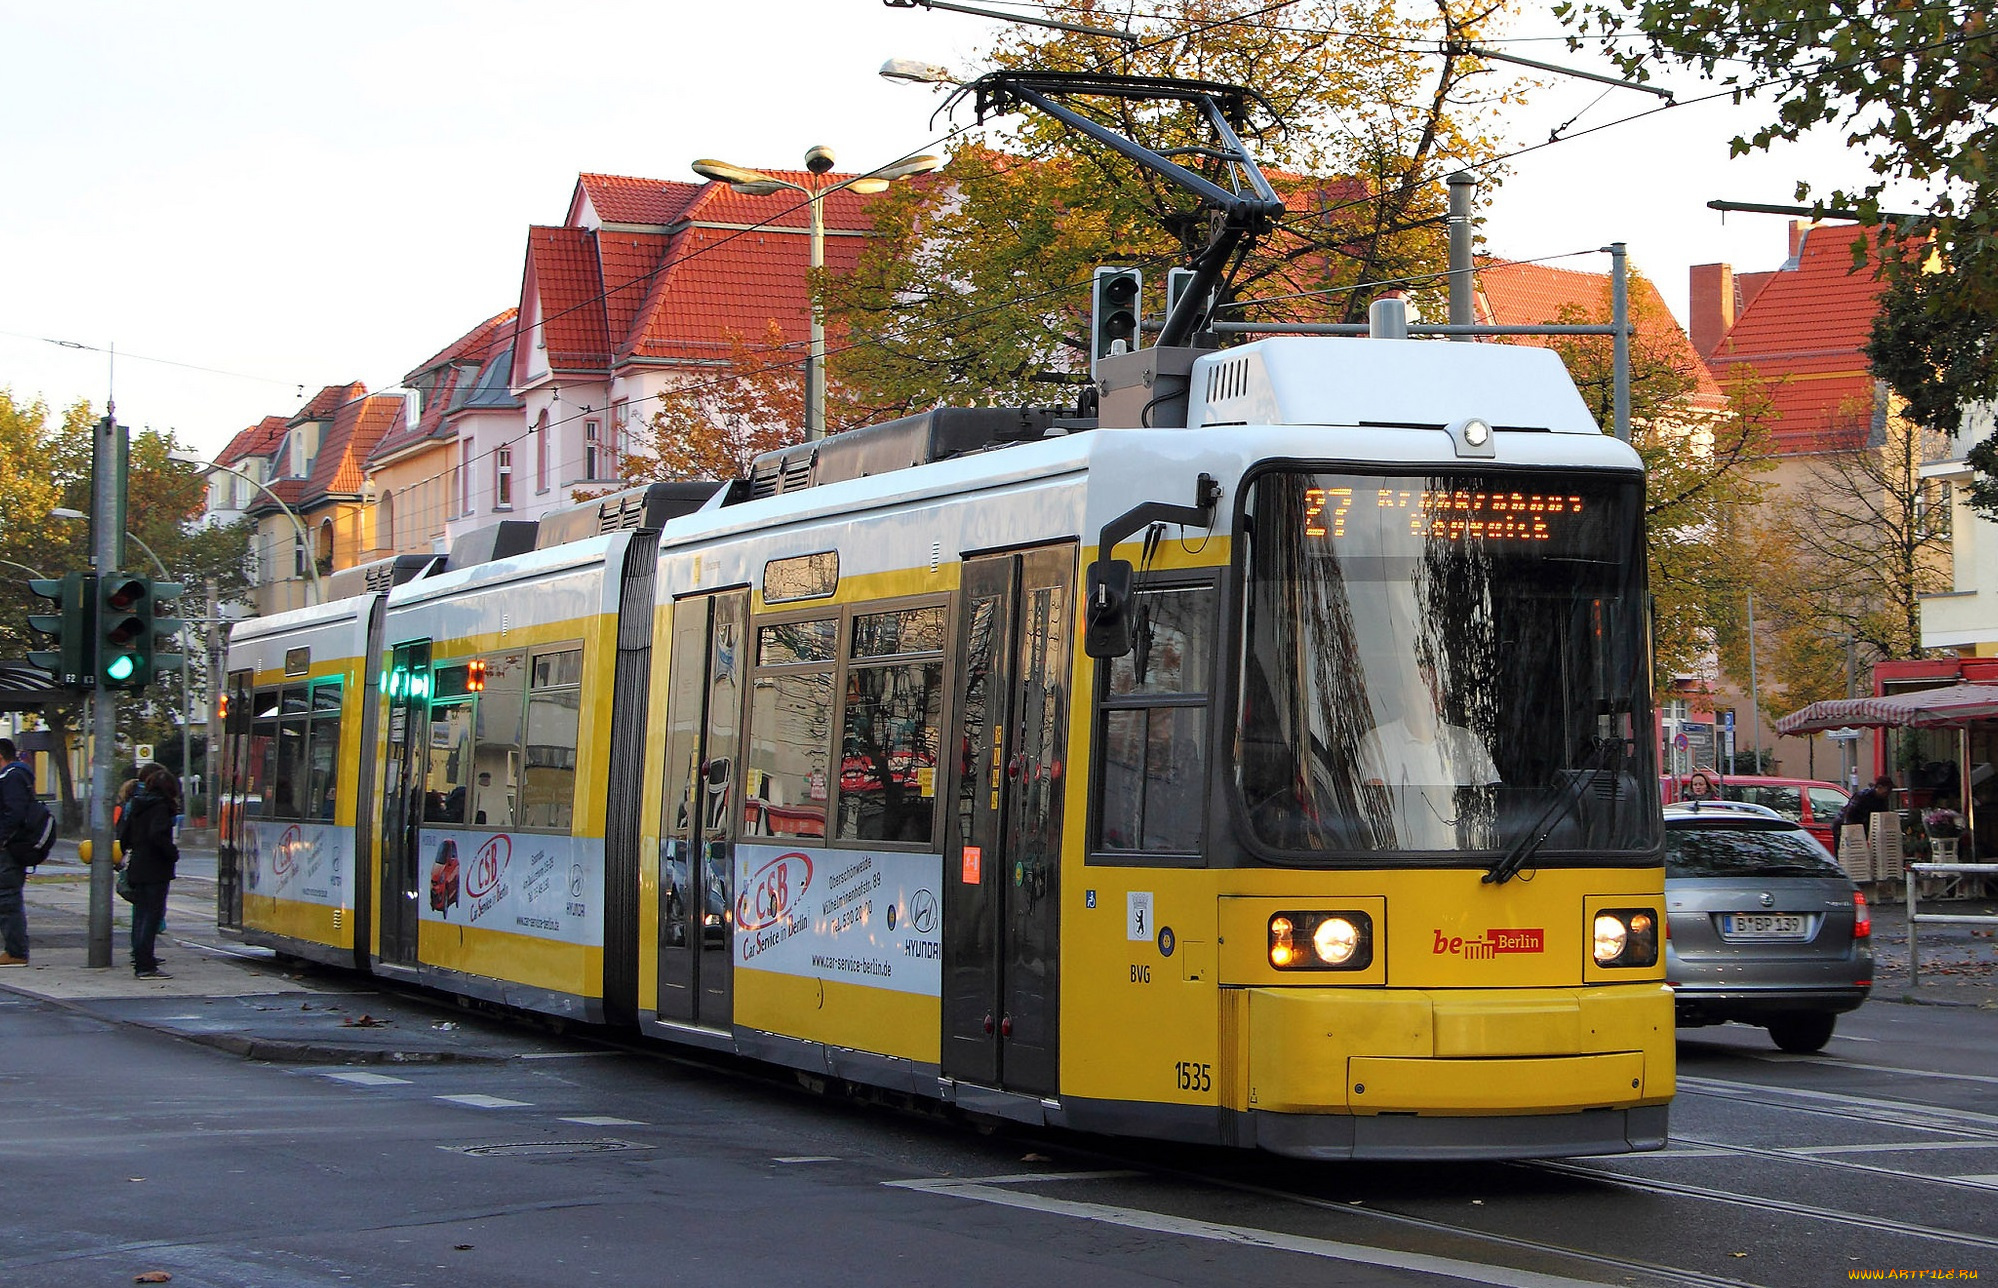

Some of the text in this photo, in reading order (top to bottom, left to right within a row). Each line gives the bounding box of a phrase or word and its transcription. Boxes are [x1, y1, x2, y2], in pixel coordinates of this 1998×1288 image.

[1304, 488, 1352, 537] 27
[478, 842, 497, 889] CSB
[828, 855, 872, 890] Oberschönweide
[756, 862, 788, 920] CSB
[743, 914, 808, 961] Car Service in Berlin
[1737, 917, 1799, 931] B BP 139
[1433, 929, 1539, 954] be Berlin
[812, 955, 892, 977] www.car-service-berlin.de
[1130, 964, 1151, 984] BVG
[1175, 1061, 1211, 1092] 1535
